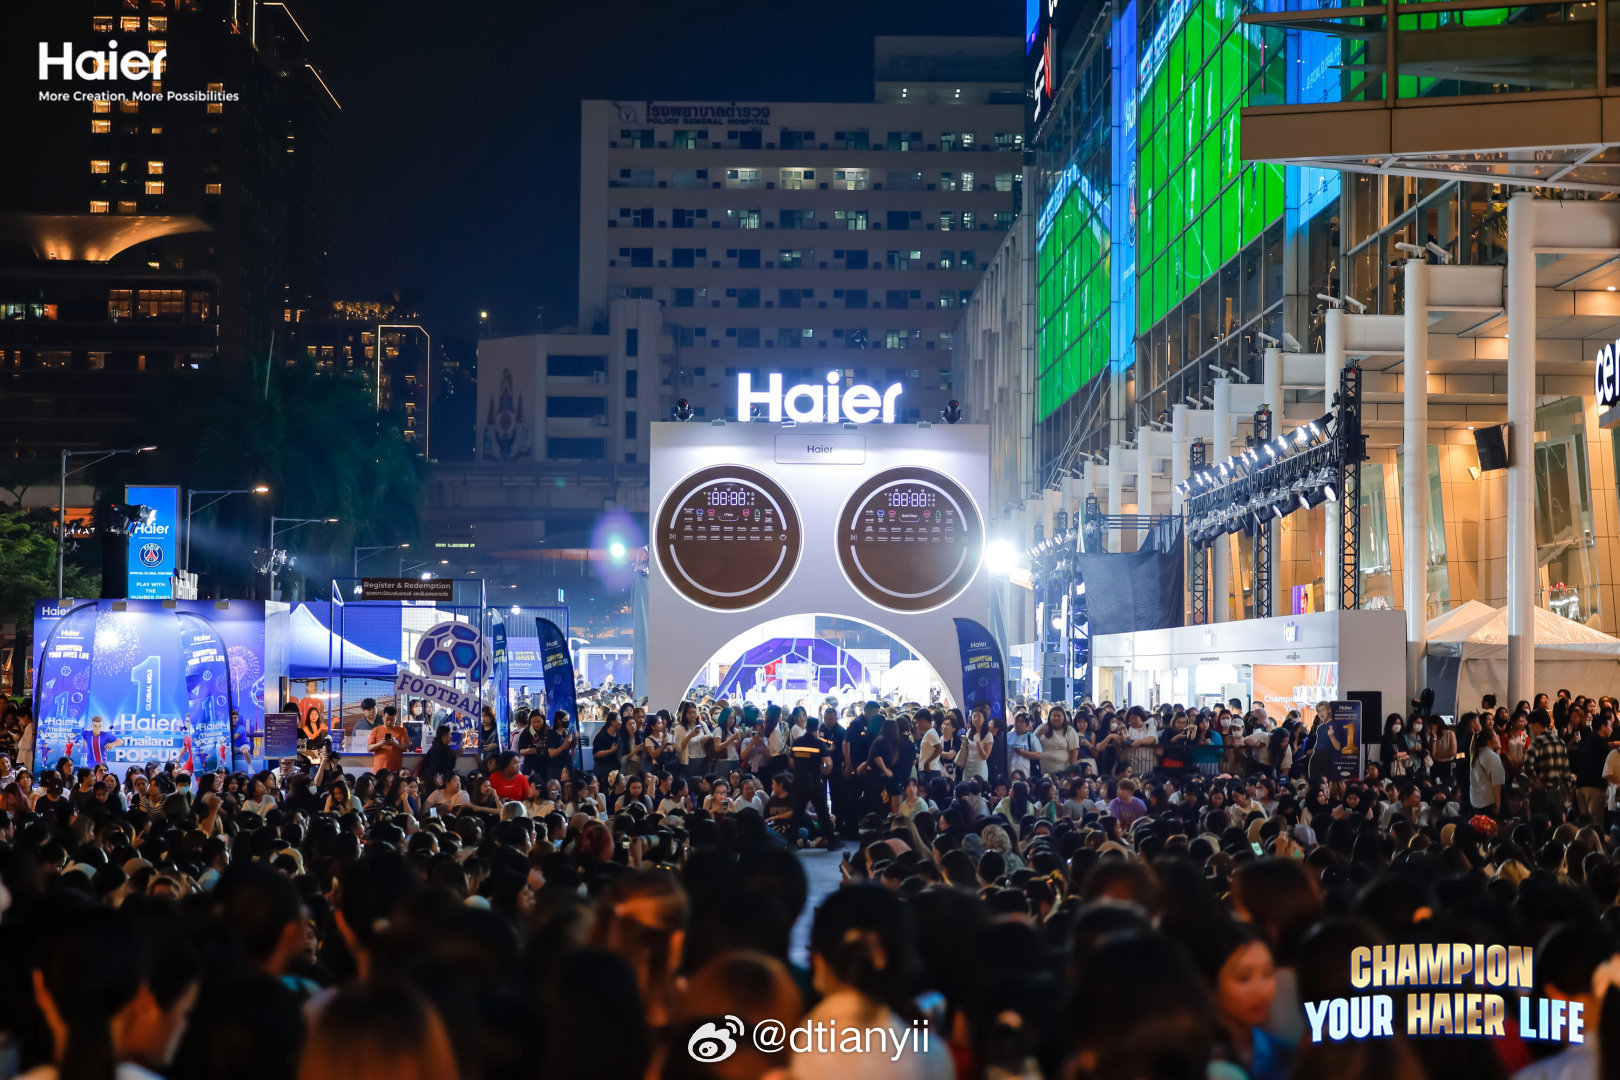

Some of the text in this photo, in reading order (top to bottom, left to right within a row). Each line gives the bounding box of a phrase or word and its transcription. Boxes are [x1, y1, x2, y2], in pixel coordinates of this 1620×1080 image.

[646, 117, 679, 125] POLICE
[737, 371, 903, 424] Haier
[807, 445, 833, 454] Haier
[711, 491, 746, 506] 88:88
[892, 492, 927, 507] 88:88
[363, 581, 395, 590] Register
[404, 581, 451, 590] Redemption
[61, 629, 80, 637] Haier
[397, 673, 482, 718] FOOTBAL
[120, 713, 177, 732] Haier
[122, 735, 174, 747] Thailand
[1341, 721, 1360, 755] 1
[115, 748, 181, 762] POP-UP
